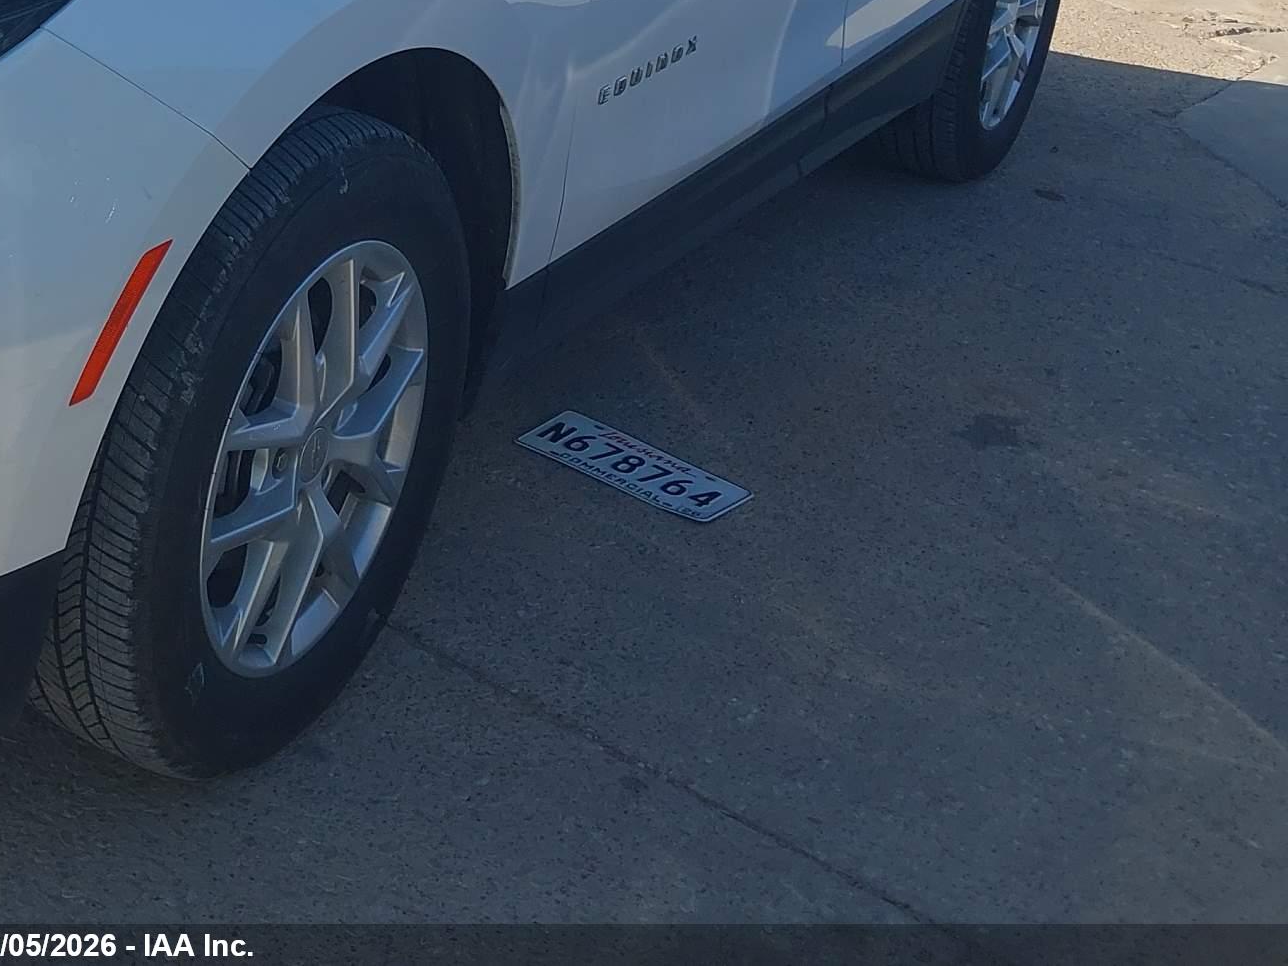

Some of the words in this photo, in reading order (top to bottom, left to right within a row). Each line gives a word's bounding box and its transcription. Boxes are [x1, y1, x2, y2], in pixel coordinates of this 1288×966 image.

[597, 34, 697, 106] EQUINOX
[536, 422, 722, 508] N678764
[561, 452, 661, 504] COMMERCIAL
